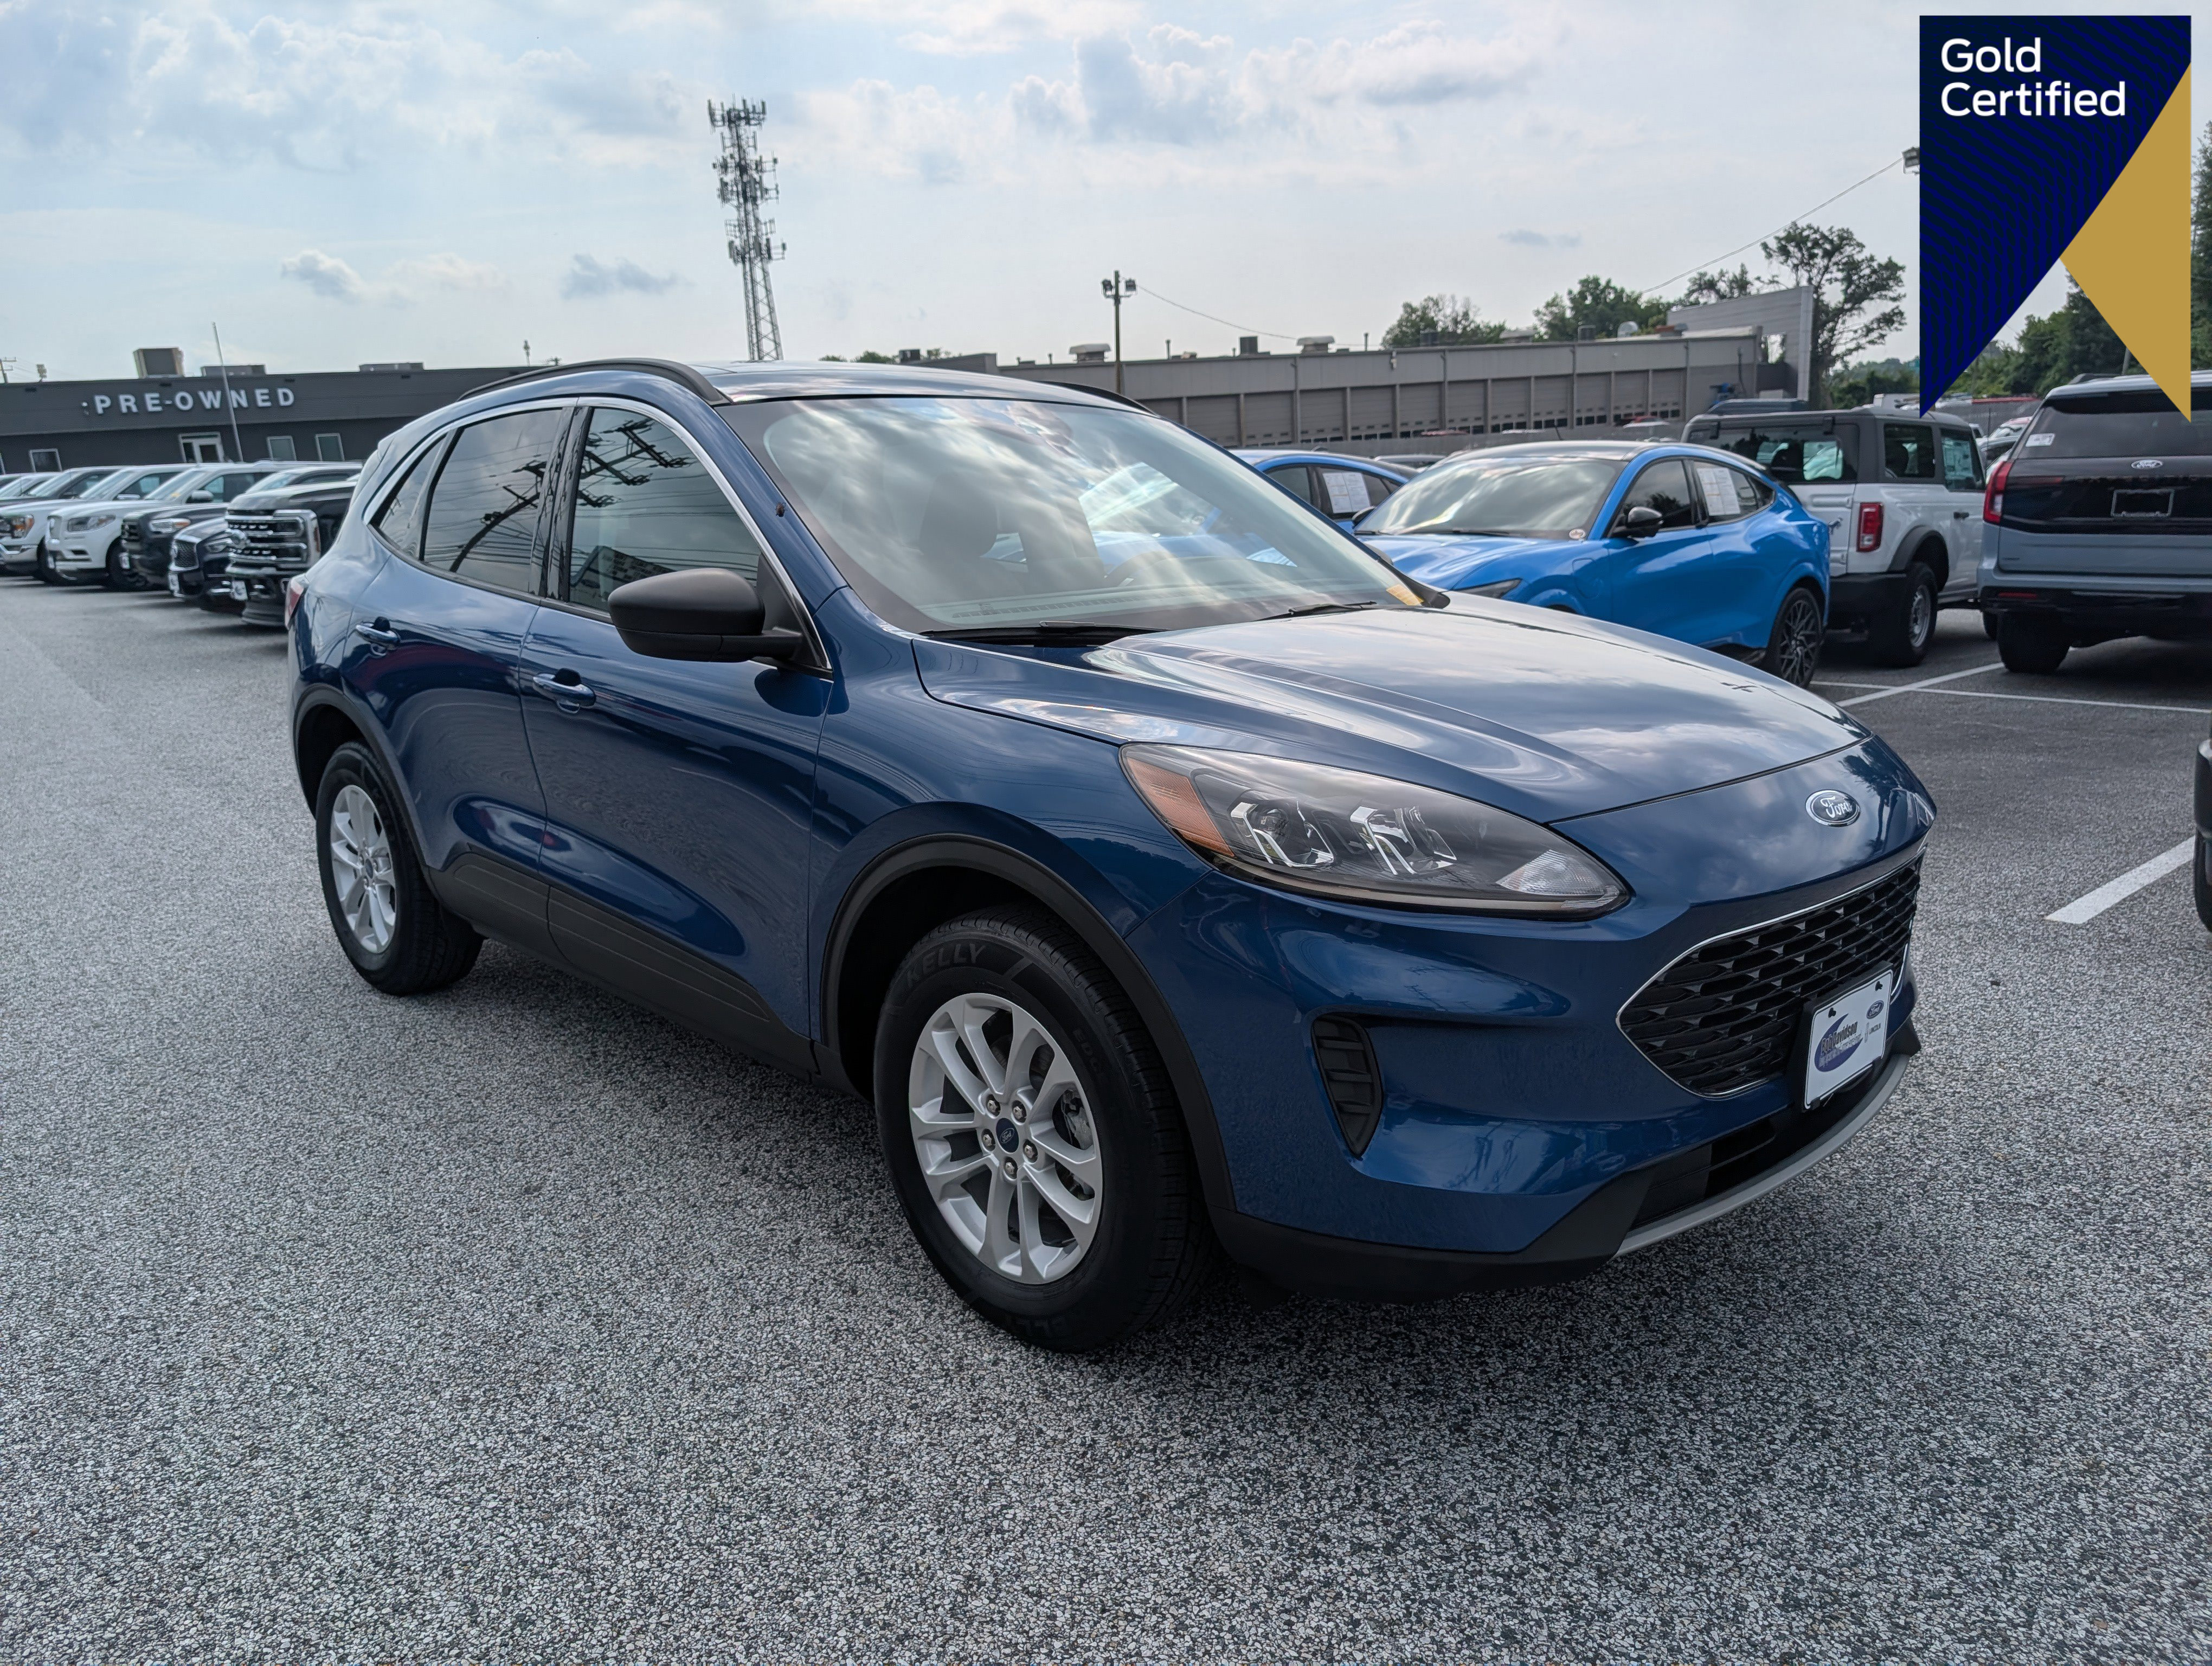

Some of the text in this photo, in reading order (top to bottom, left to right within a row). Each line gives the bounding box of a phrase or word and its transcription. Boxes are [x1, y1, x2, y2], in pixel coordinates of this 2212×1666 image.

[93, 387, 295, 414] PRE-OWNED
[1819, 795, 1853, 819] Ford
[907, 942, 987, 988] KELLY
[1832, 1021, 1858, 1047] Davidson
